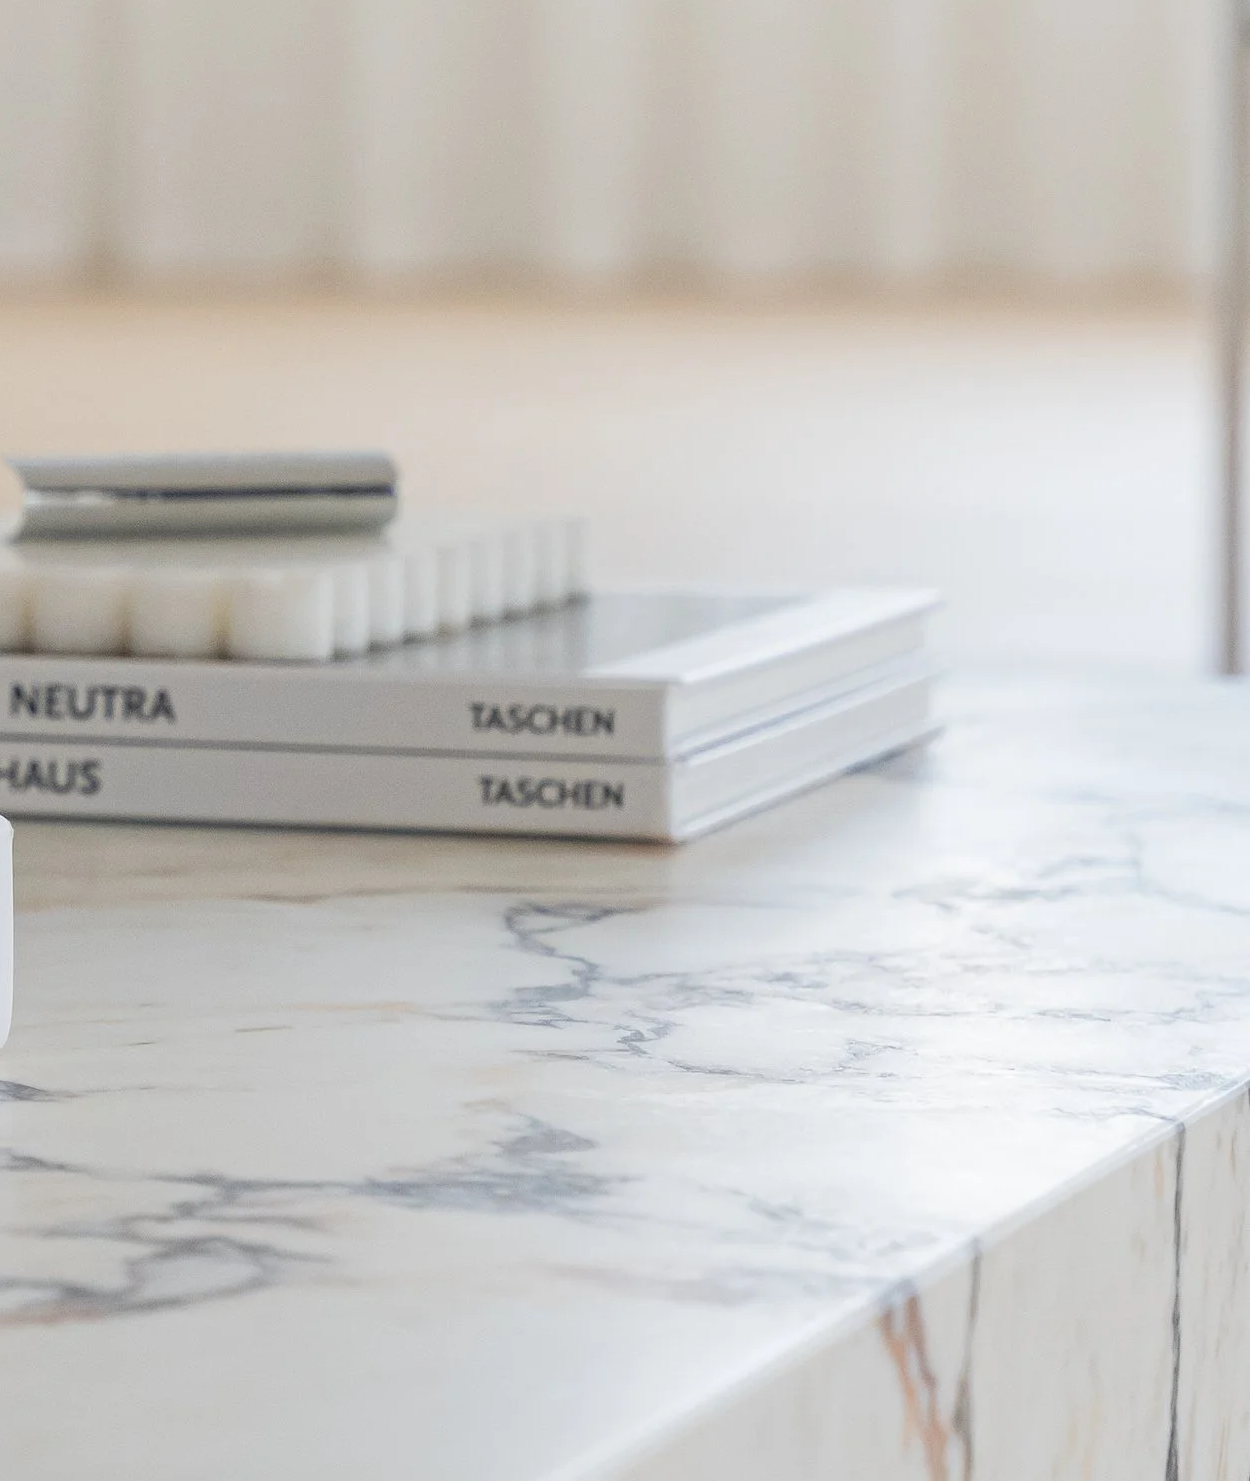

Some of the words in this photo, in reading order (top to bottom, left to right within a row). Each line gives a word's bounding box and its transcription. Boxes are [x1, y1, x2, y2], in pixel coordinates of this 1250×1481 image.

[7, 680, 177, 724] NEUTRA
[469, 701, 617, 736] TASCHEN
[479, 774, 626, 811] TASCHEN
